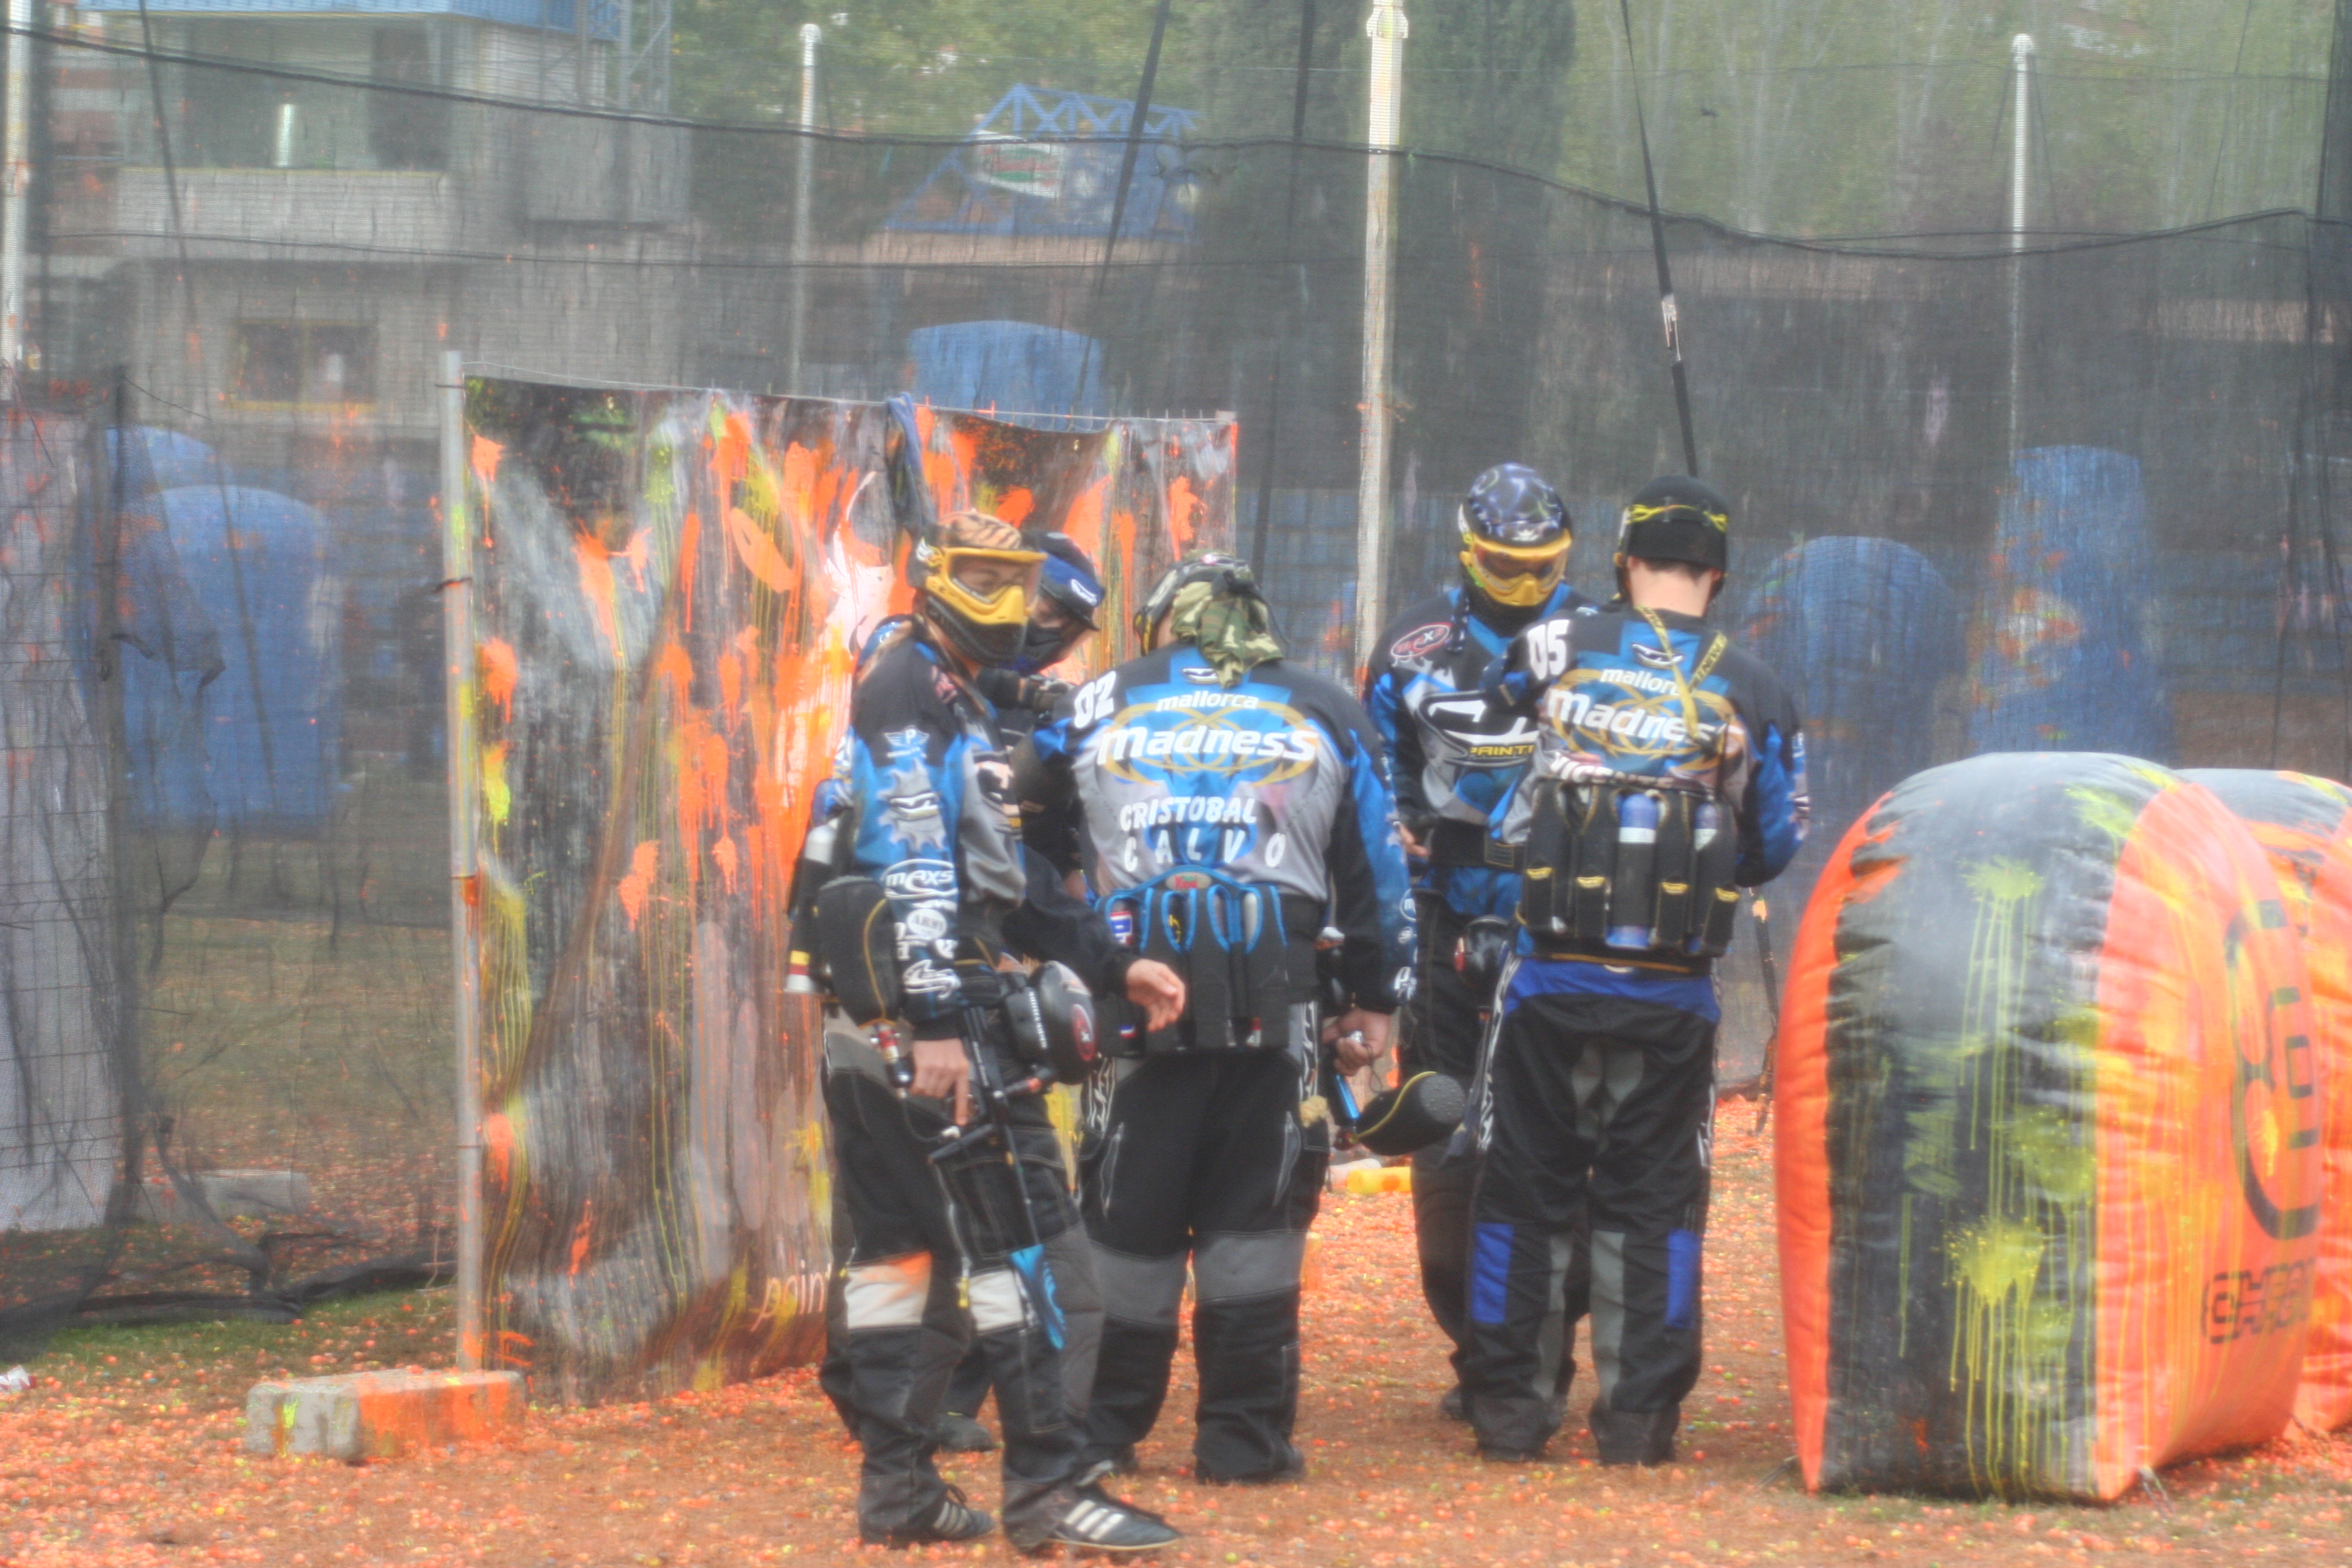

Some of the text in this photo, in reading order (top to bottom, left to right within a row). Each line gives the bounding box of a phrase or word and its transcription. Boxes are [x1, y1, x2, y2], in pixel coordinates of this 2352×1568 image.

[1526, 619, 1571, 680] 05
[1073, 670, 1117, 728] 02
[1156, 690, 1259, 712] mallorca
[1599, 668, 1681, 697] mallor
[1547, 687, 1744, 745] madnes
[1120, 796, 1257, 832] CRISTOBAL
[750, 1258, 832, 1333] pain
